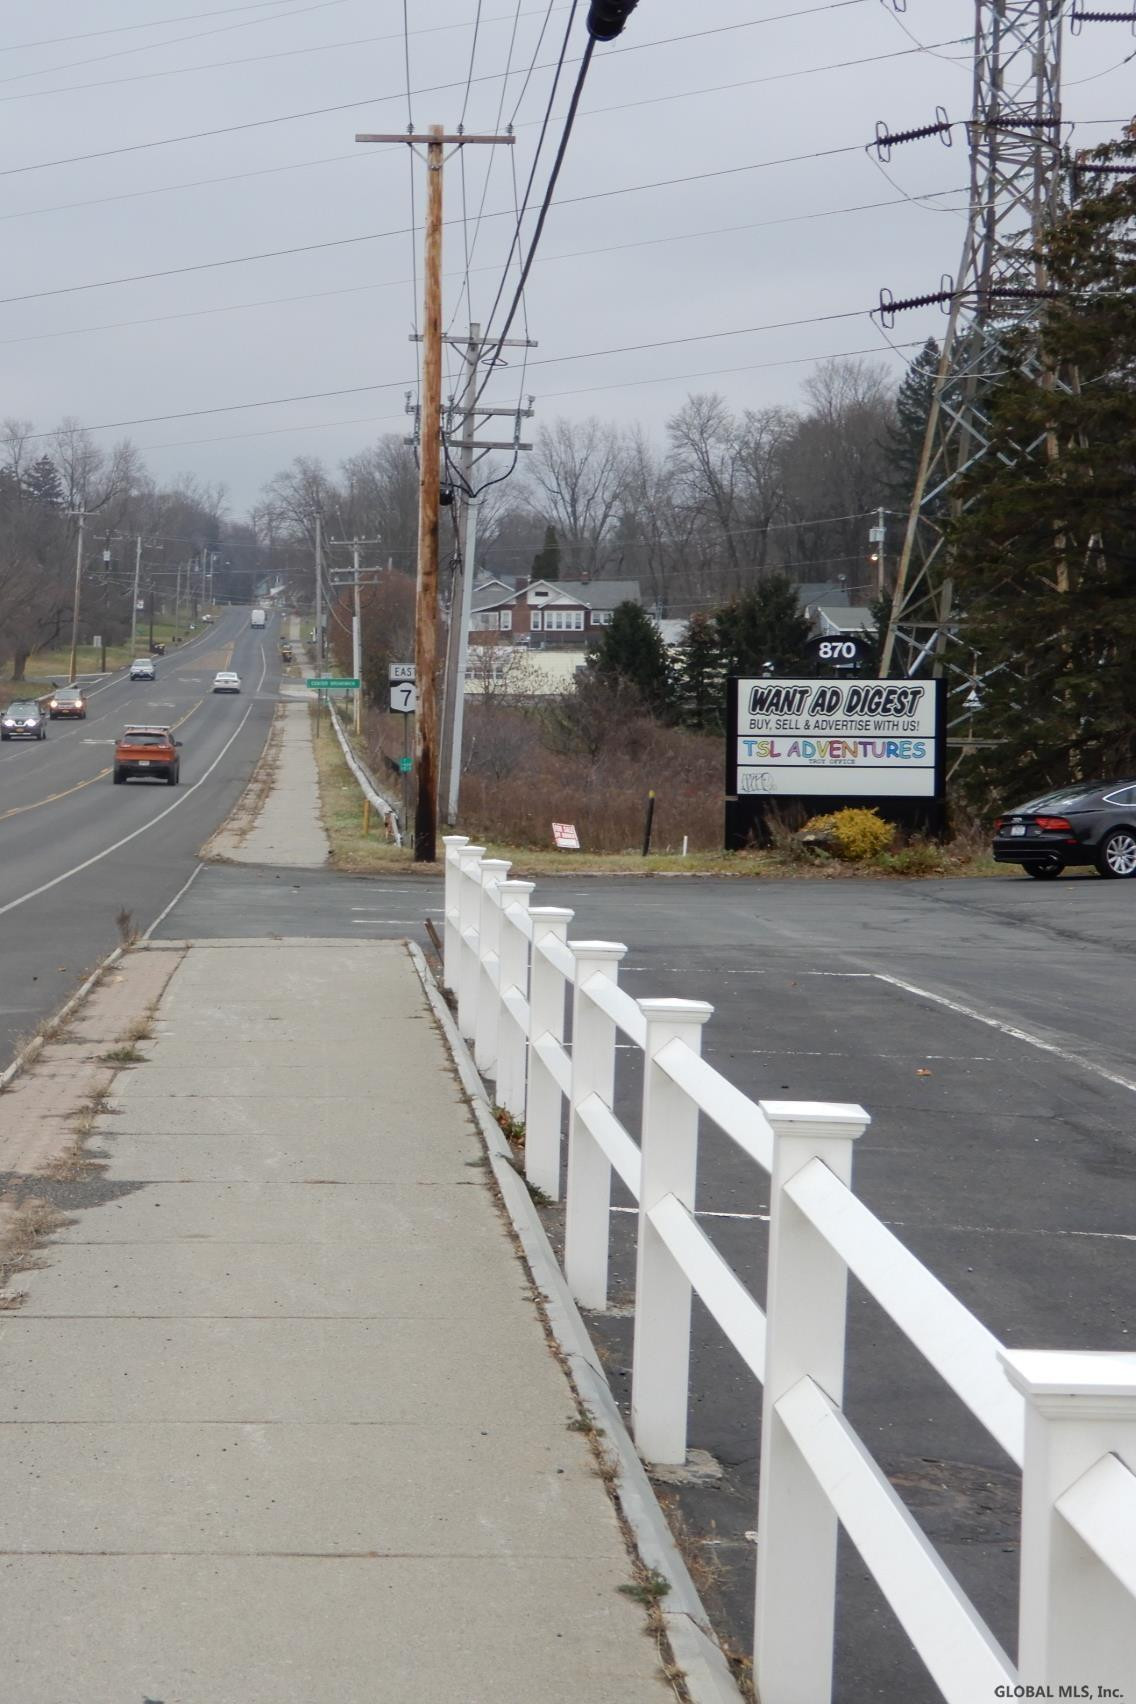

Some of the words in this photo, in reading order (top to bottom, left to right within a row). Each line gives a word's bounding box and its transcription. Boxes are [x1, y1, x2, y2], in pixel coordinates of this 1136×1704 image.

[819, 642, 856, 659] 870
[400, 689, 412, 706] 7
[749, 685, 812, 715] WANT
[808, 685, 843, 716] AD
[843, 685, 924, 717] DIGEST
[749, 719, 772, 731] BUY,
[775, 719, 800, 731] SELL
[803, 720, 811, 731] &
[814, 720, 871, 731] ADVERTISE
[873, 720, 899, 732] WITH
[902, 720, 920, 732] US!
[743, 740, 782, 758] TSL
[787, 740, 927, 759] ADVENTURES
